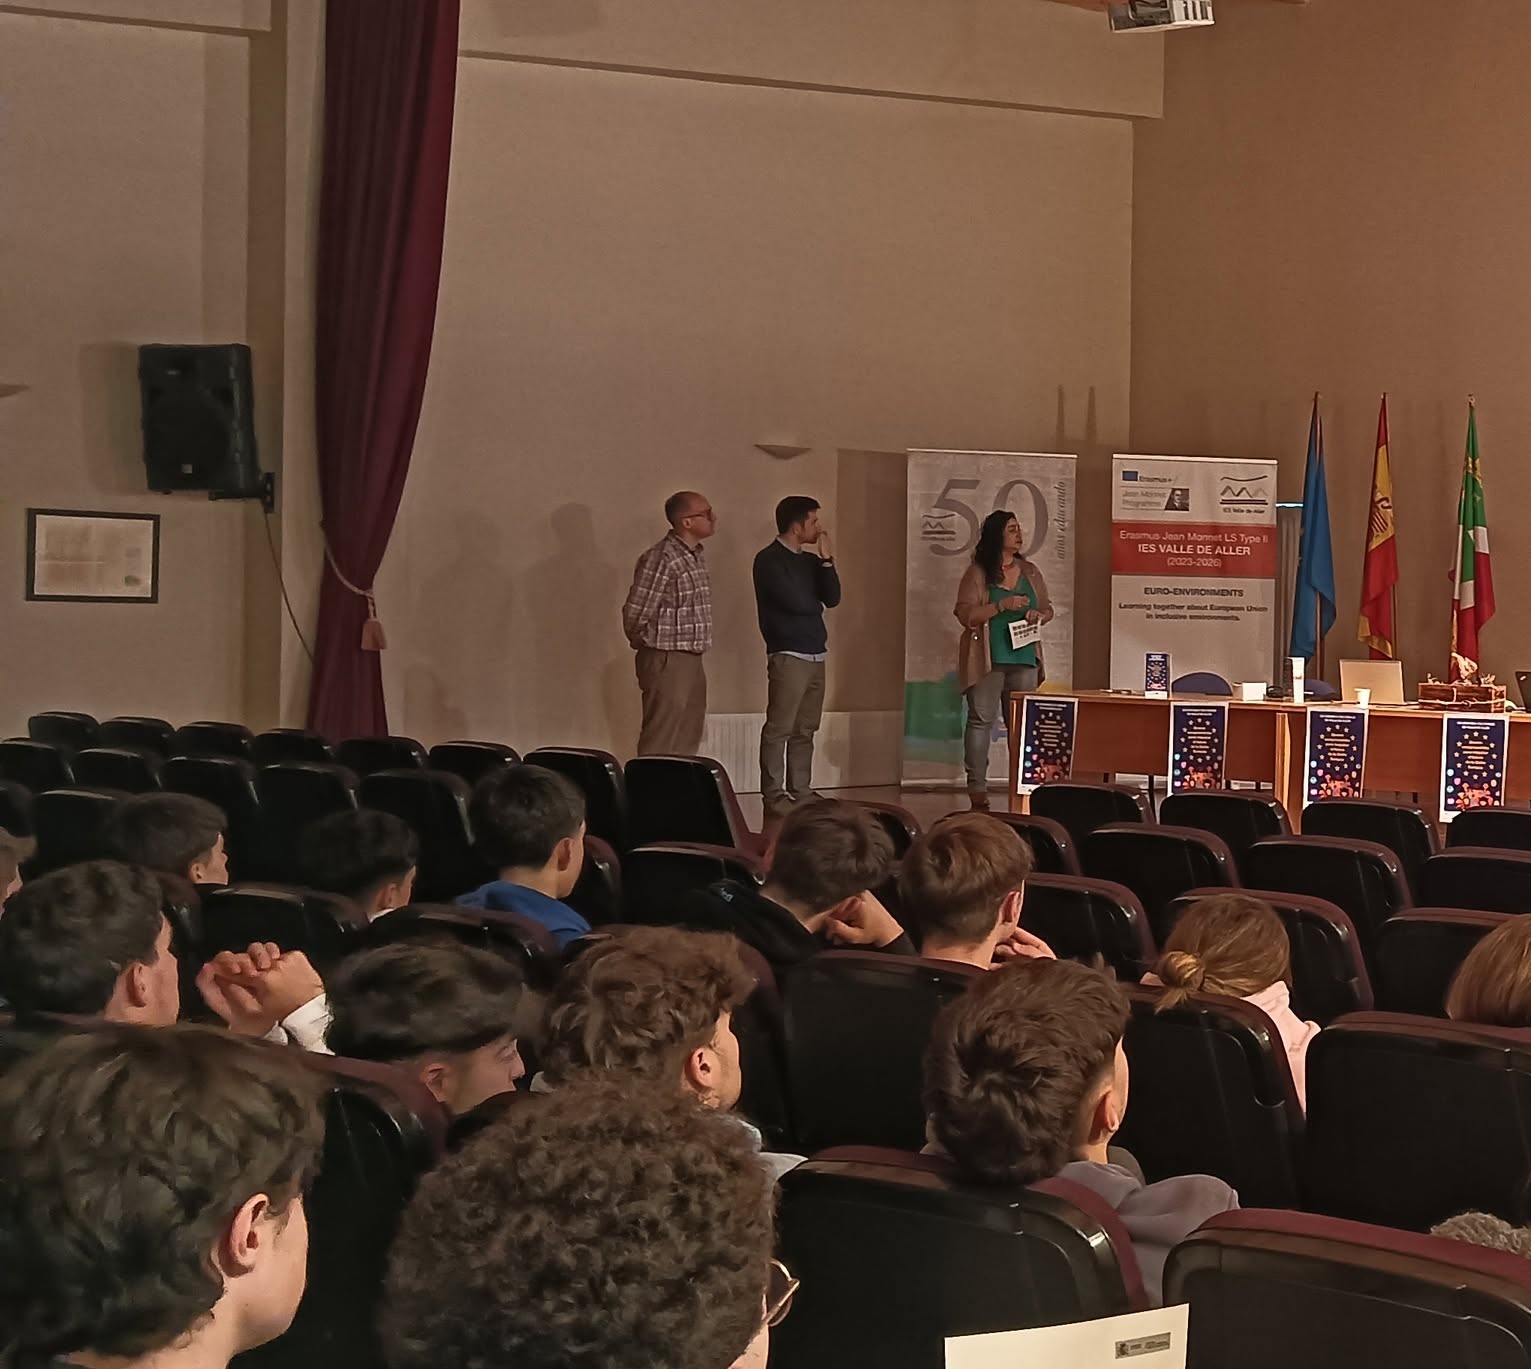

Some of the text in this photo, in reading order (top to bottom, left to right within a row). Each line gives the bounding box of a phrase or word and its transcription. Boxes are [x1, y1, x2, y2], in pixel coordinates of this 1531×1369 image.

[1053, 481, 1065, 532] educando
[930, 479, 1048, 559] 50
[1120, 531, 1159, 540] Erasmus
[1188, 533, 1222, 541] Monnet
[1240, 535, 1261, 544] Type
[1138, 544, 1250, 555] IES VALLE DE ALLER
[1167, 558, 1221, 567] (2023-2026)
[1144, 588, 1244, 597] EURO-ENVIRONMENTS
